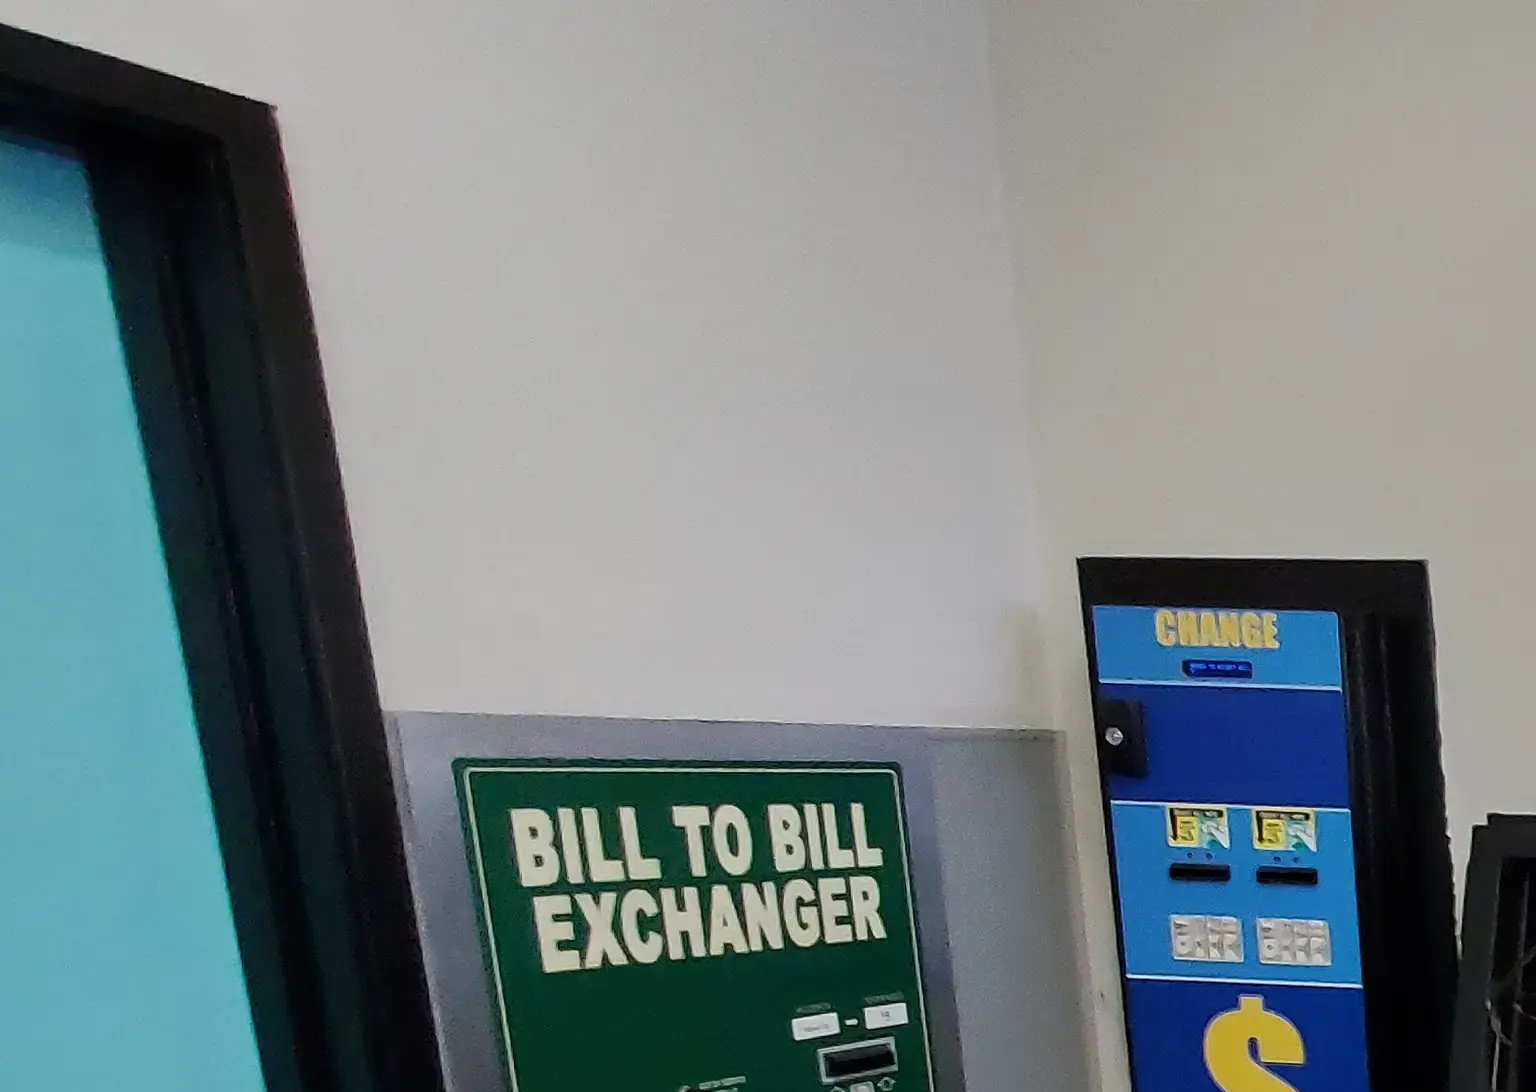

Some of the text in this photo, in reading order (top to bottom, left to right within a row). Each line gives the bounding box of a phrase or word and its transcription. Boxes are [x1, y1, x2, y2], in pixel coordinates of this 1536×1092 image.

[1154, 609, 1280, 649] CHANGE
[508, 803, 884, 889] BILL TO BILL
[531, 875, 888, 975] EXCHANGER
